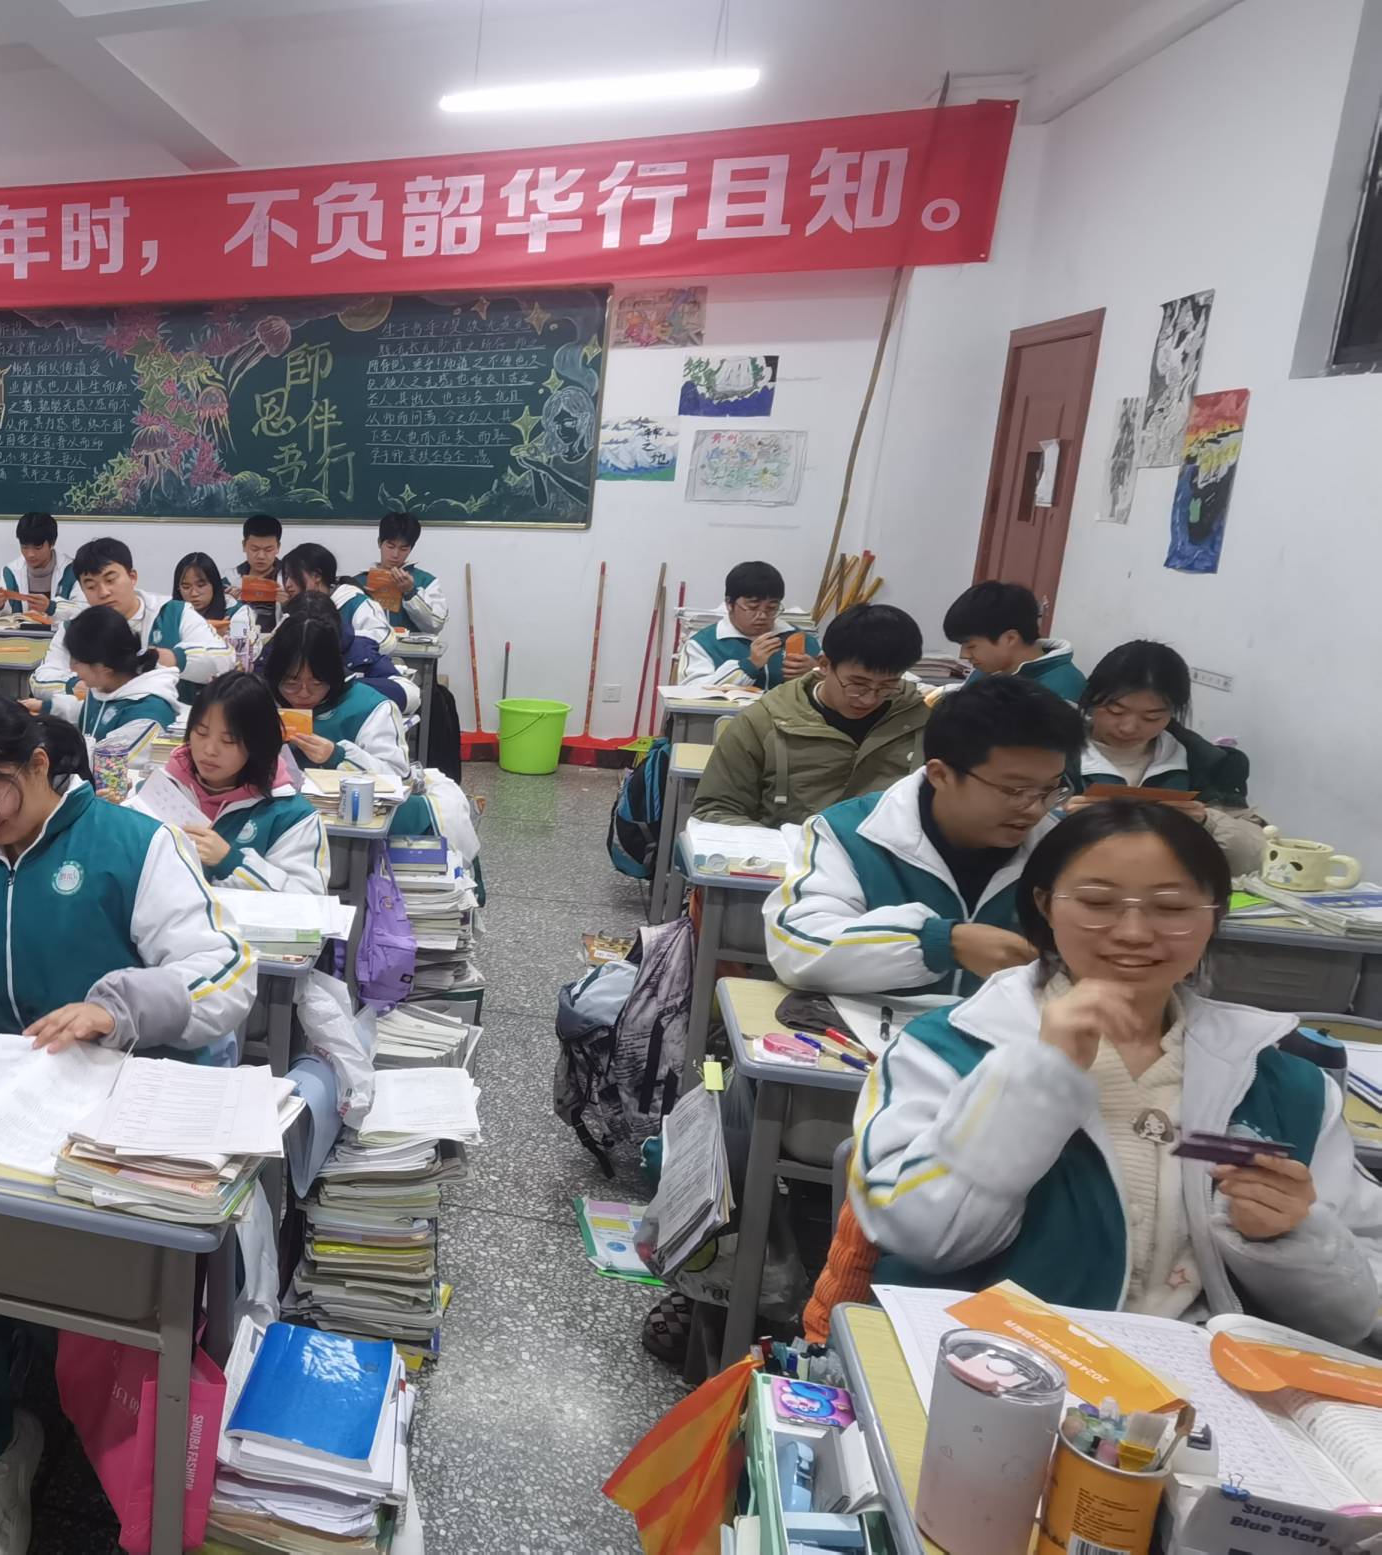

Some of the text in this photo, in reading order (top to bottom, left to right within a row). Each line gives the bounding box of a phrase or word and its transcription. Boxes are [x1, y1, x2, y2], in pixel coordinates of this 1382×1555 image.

[224, 146, 962, 268] 不负韶华行且知。
[1230, 1516, 1331, 1548] Blue Story
[1241, 1503, 1327, 1532] Sleeping
